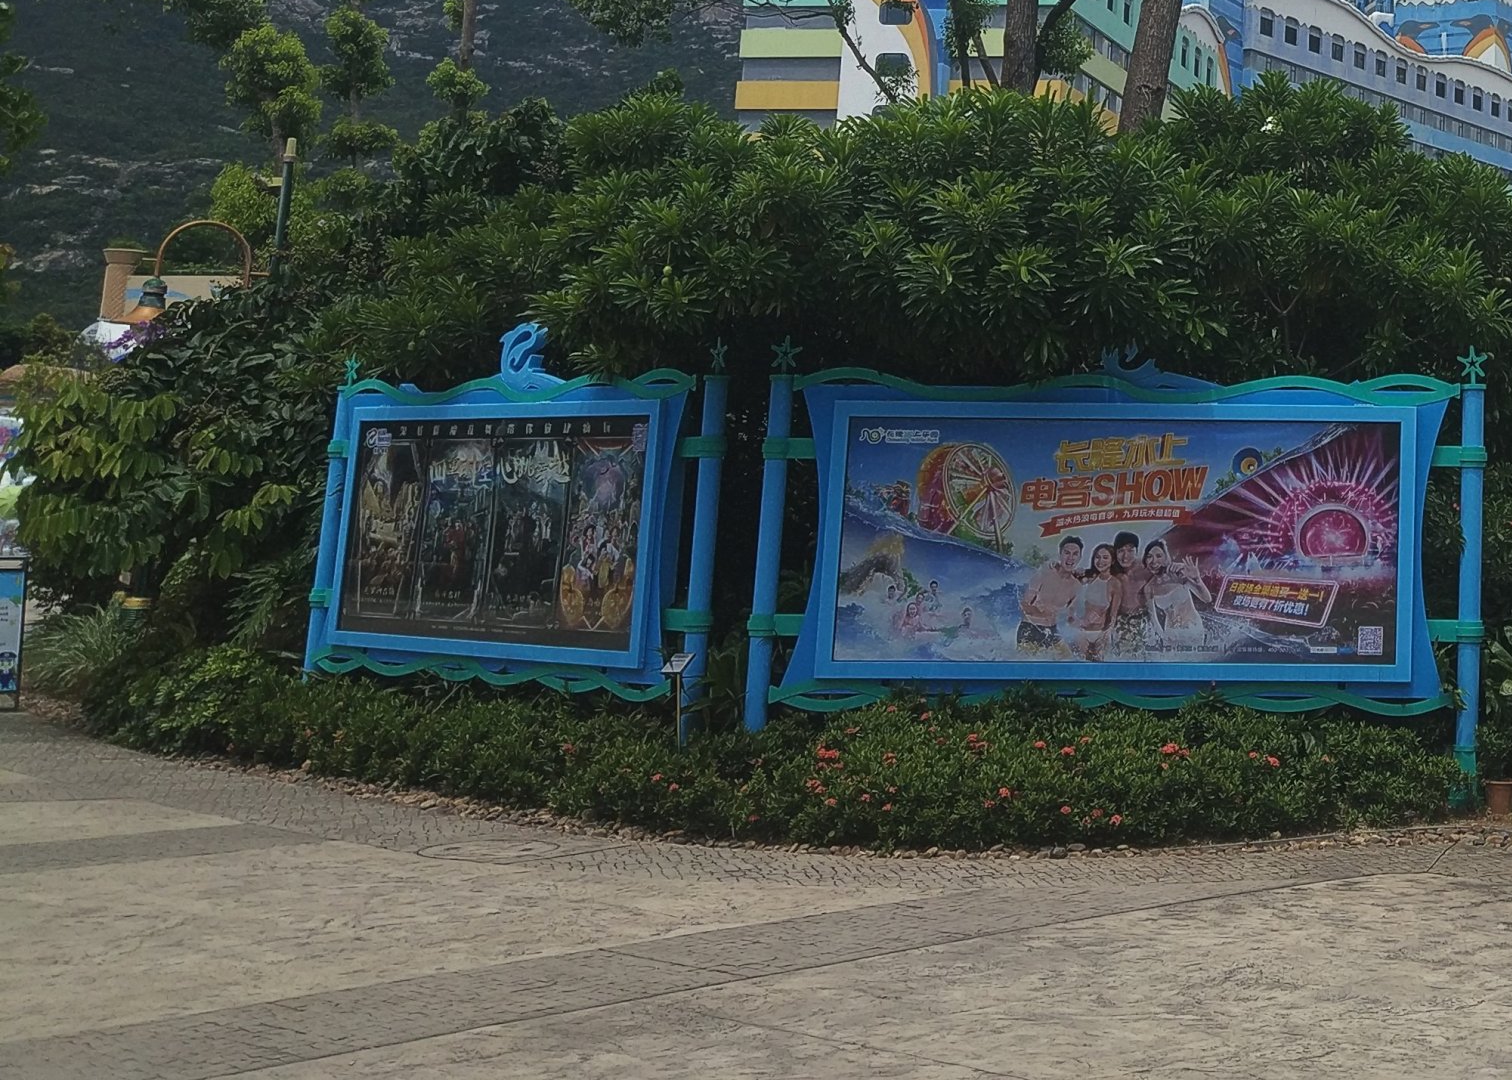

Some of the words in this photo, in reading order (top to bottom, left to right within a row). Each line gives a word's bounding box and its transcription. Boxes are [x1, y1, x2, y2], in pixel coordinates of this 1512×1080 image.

[1054, 433, 1188, 473] 长隆水上
[1021, 467, 1209, 511] 电音SHOW
